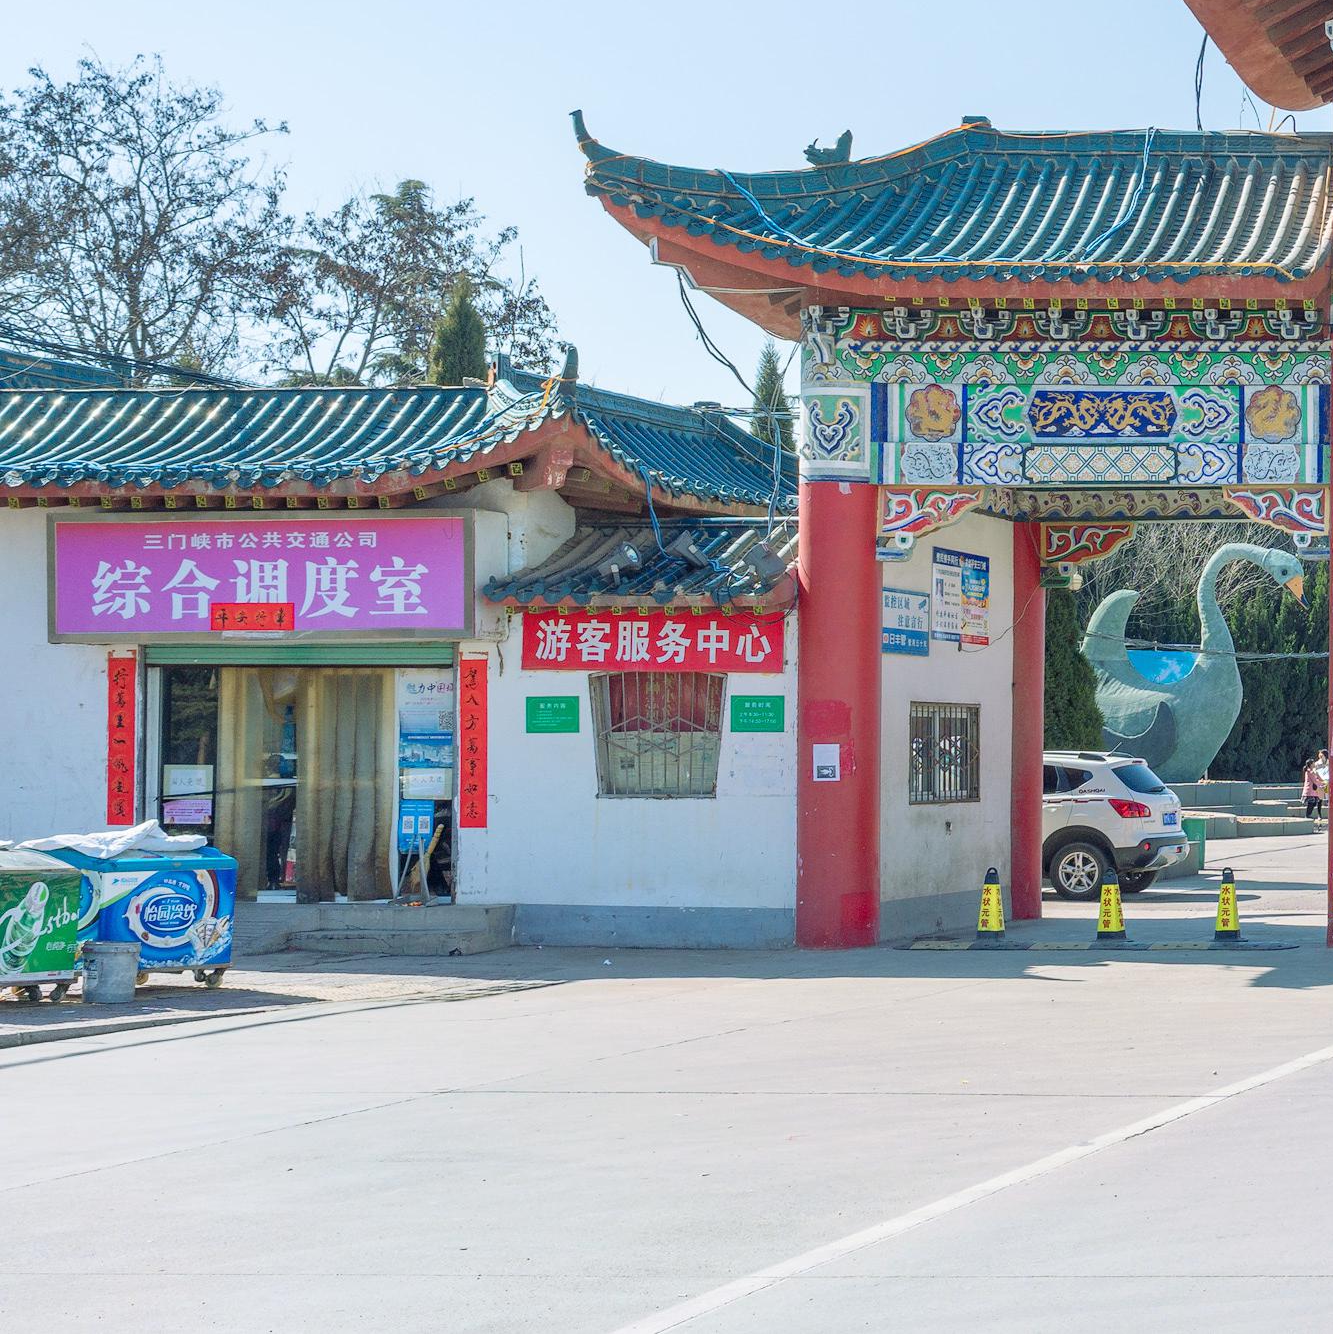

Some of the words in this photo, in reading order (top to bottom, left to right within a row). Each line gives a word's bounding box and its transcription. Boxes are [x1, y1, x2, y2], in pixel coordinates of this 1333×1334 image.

[143, 531, 379, 550] 三门峡市公共交通公司
[91, 556, 430, 621] 综合调度室
[535, 618, 772, 664] 游客服务中心
[980, 886, 992, 928] 水状元管
[1103, 886, 1113, 929] 水状元管
[1221, 885, 1231, 928] 水状元管
